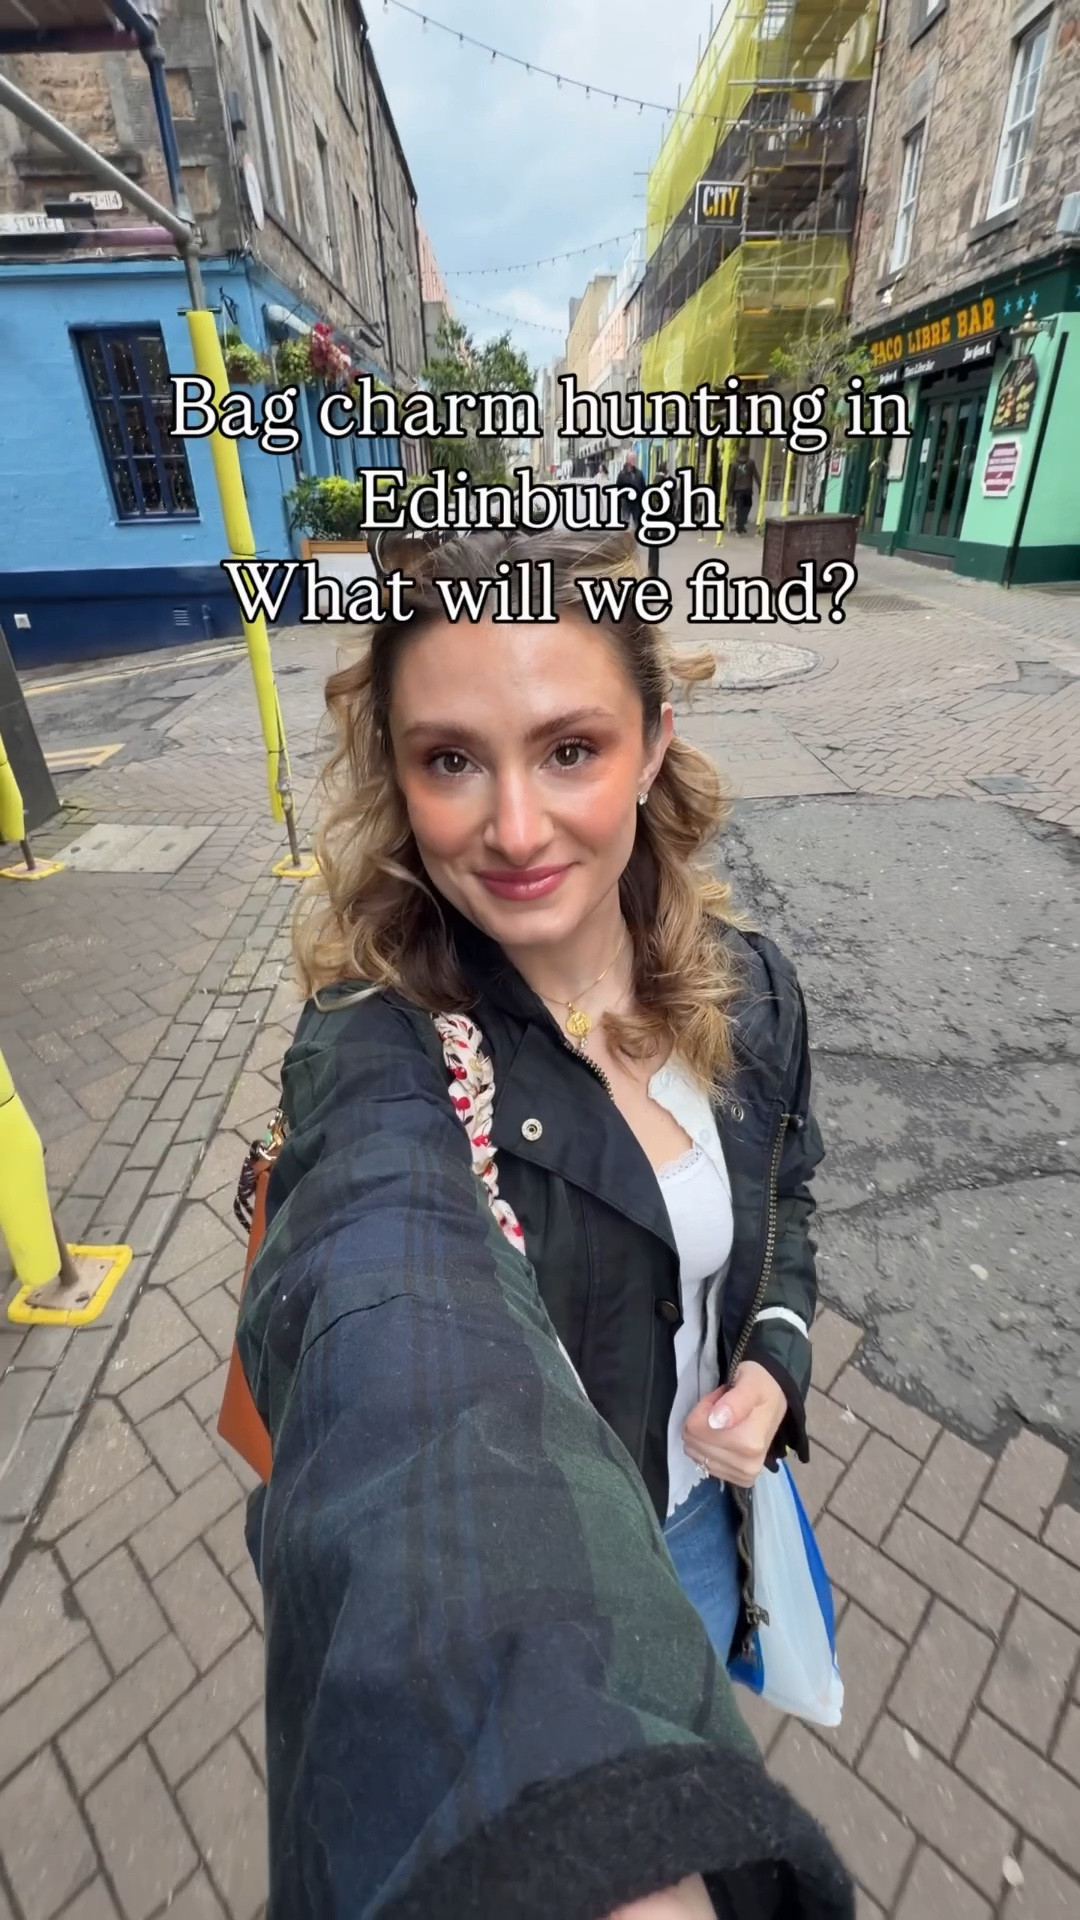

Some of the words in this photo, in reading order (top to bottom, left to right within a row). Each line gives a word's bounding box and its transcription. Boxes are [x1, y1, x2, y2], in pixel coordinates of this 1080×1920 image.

[702, 185, 740, 217] CITY
[871, 335, 903, 367] TACO
[907, 317, 951, 354] LIBRE
[957, 297, 995, 339] BAR
